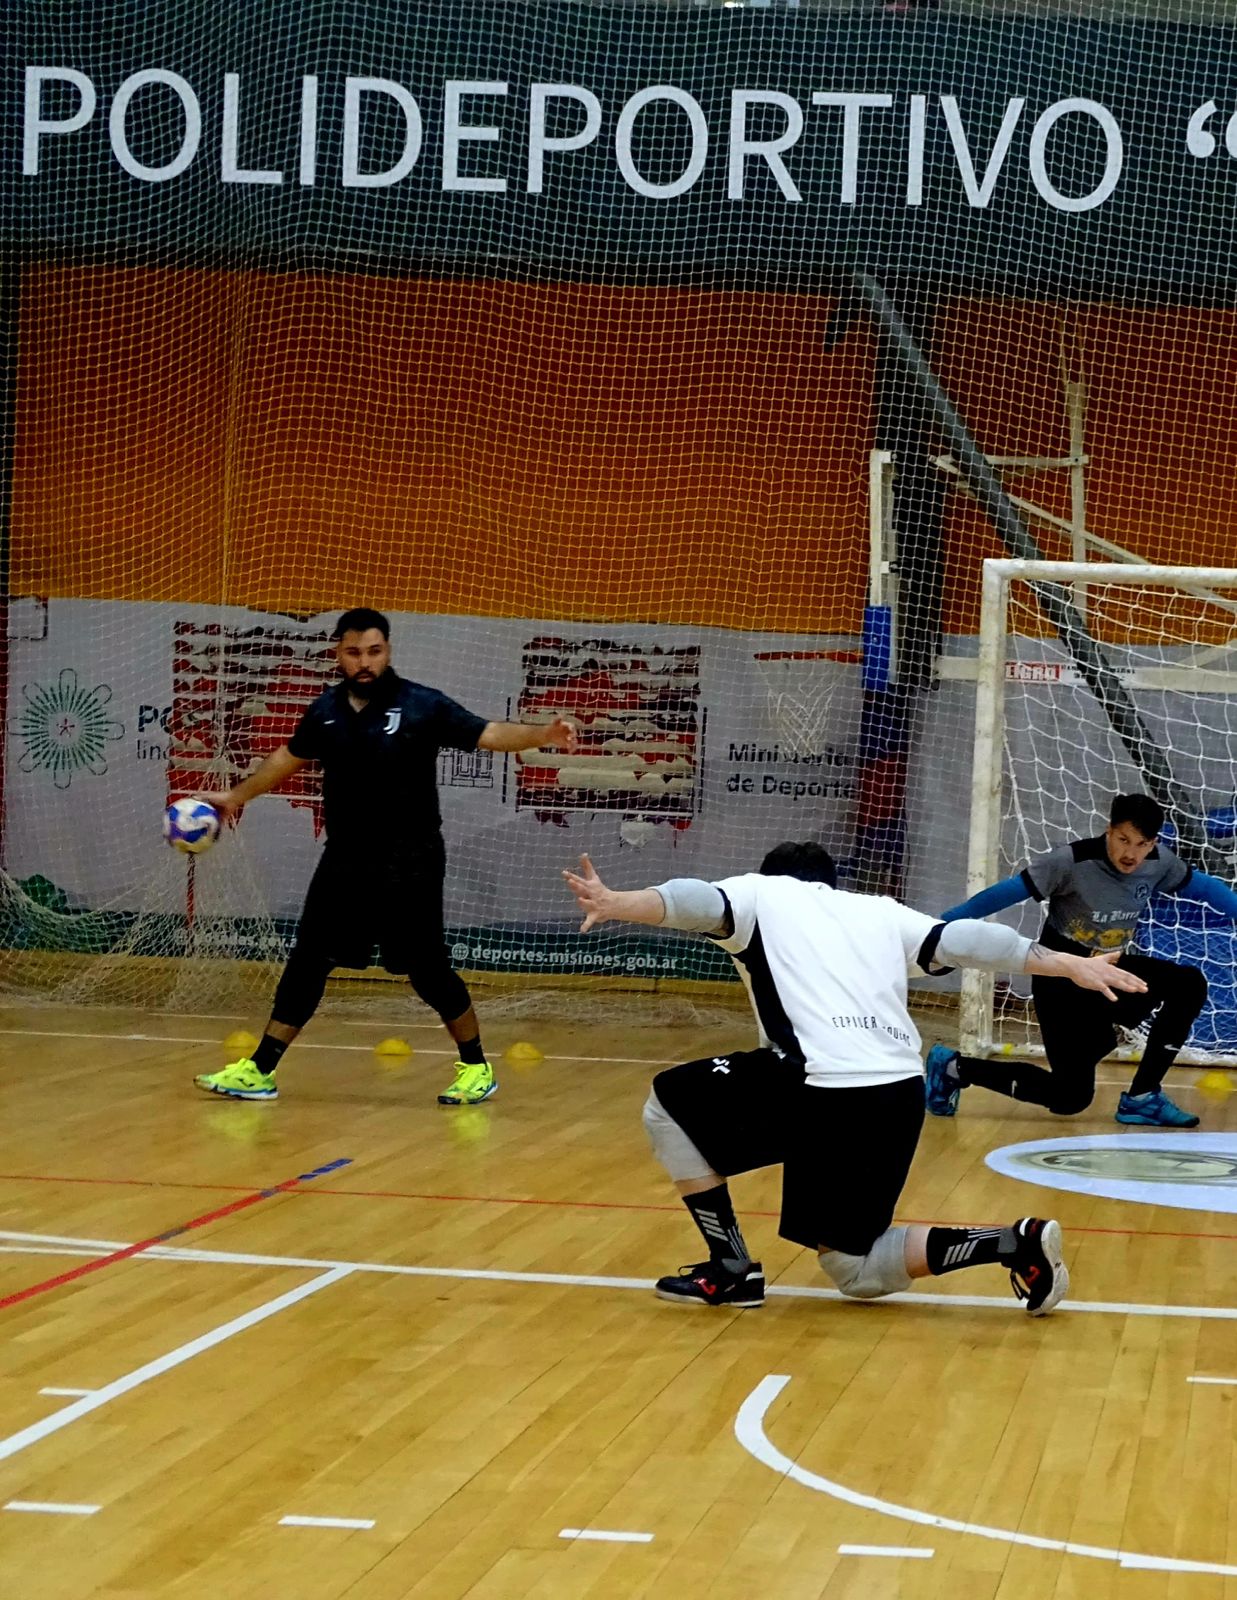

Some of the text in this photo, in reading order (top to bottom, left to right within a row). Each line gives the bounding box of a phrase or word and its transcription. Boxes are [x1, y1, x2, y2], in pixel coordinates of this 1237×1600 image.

[22, 65, 1124, 213] POLIDEPORTIVO
[727, 773, 754, 793] de
[471, 945, 678, 970] deportes.misiones.gob.ar
